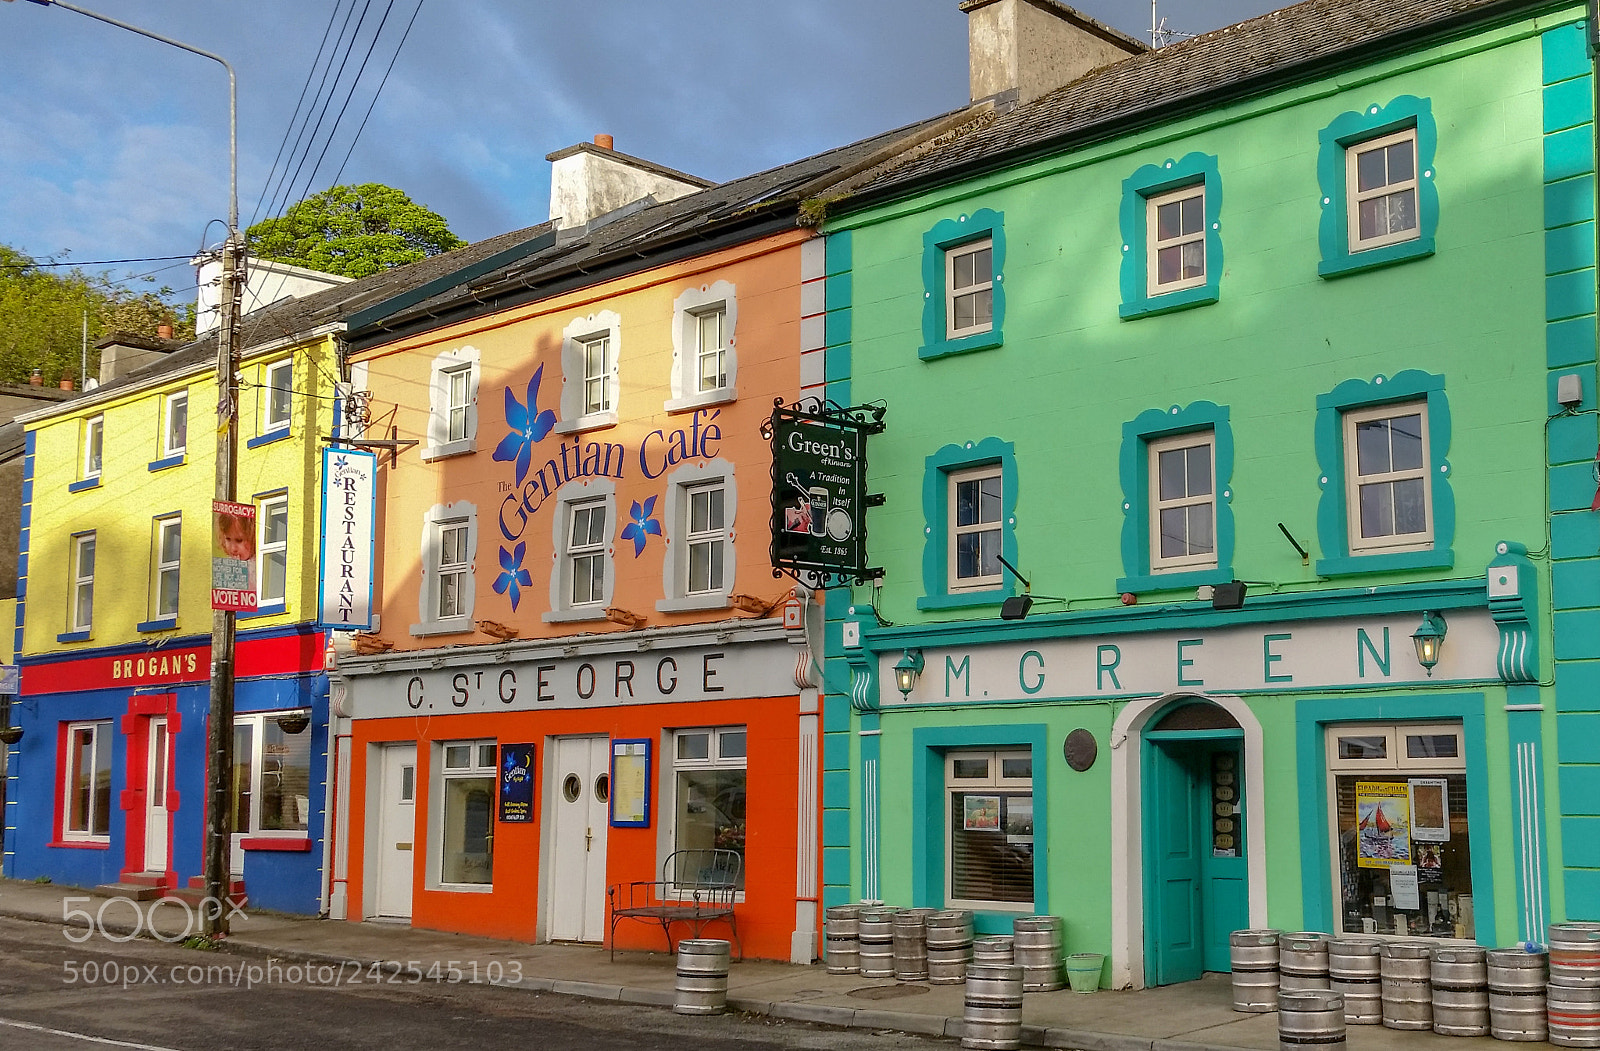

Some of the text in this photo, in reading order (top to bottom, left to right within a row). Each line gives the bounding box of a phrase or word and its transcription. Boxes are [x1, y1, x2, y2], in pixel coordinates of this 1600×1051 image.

[335, 467, 361, 479] Gentian
[497, 408, 722, 542] The Gentian Café
[809, 471, 850, 485] A Tradition
[213, 501, 255, 517] SURROGACY?
[339, 477, 357, 622] RESTAURANT
[213, 589, 256, 606] VOTE NO
[112, 653, 197, 679] BROGAN'S
[945, 627, 1391, 698] M. GREEN
[406, 676, 434, 709] C.
[497, 652, 725, 704] GEORGE
